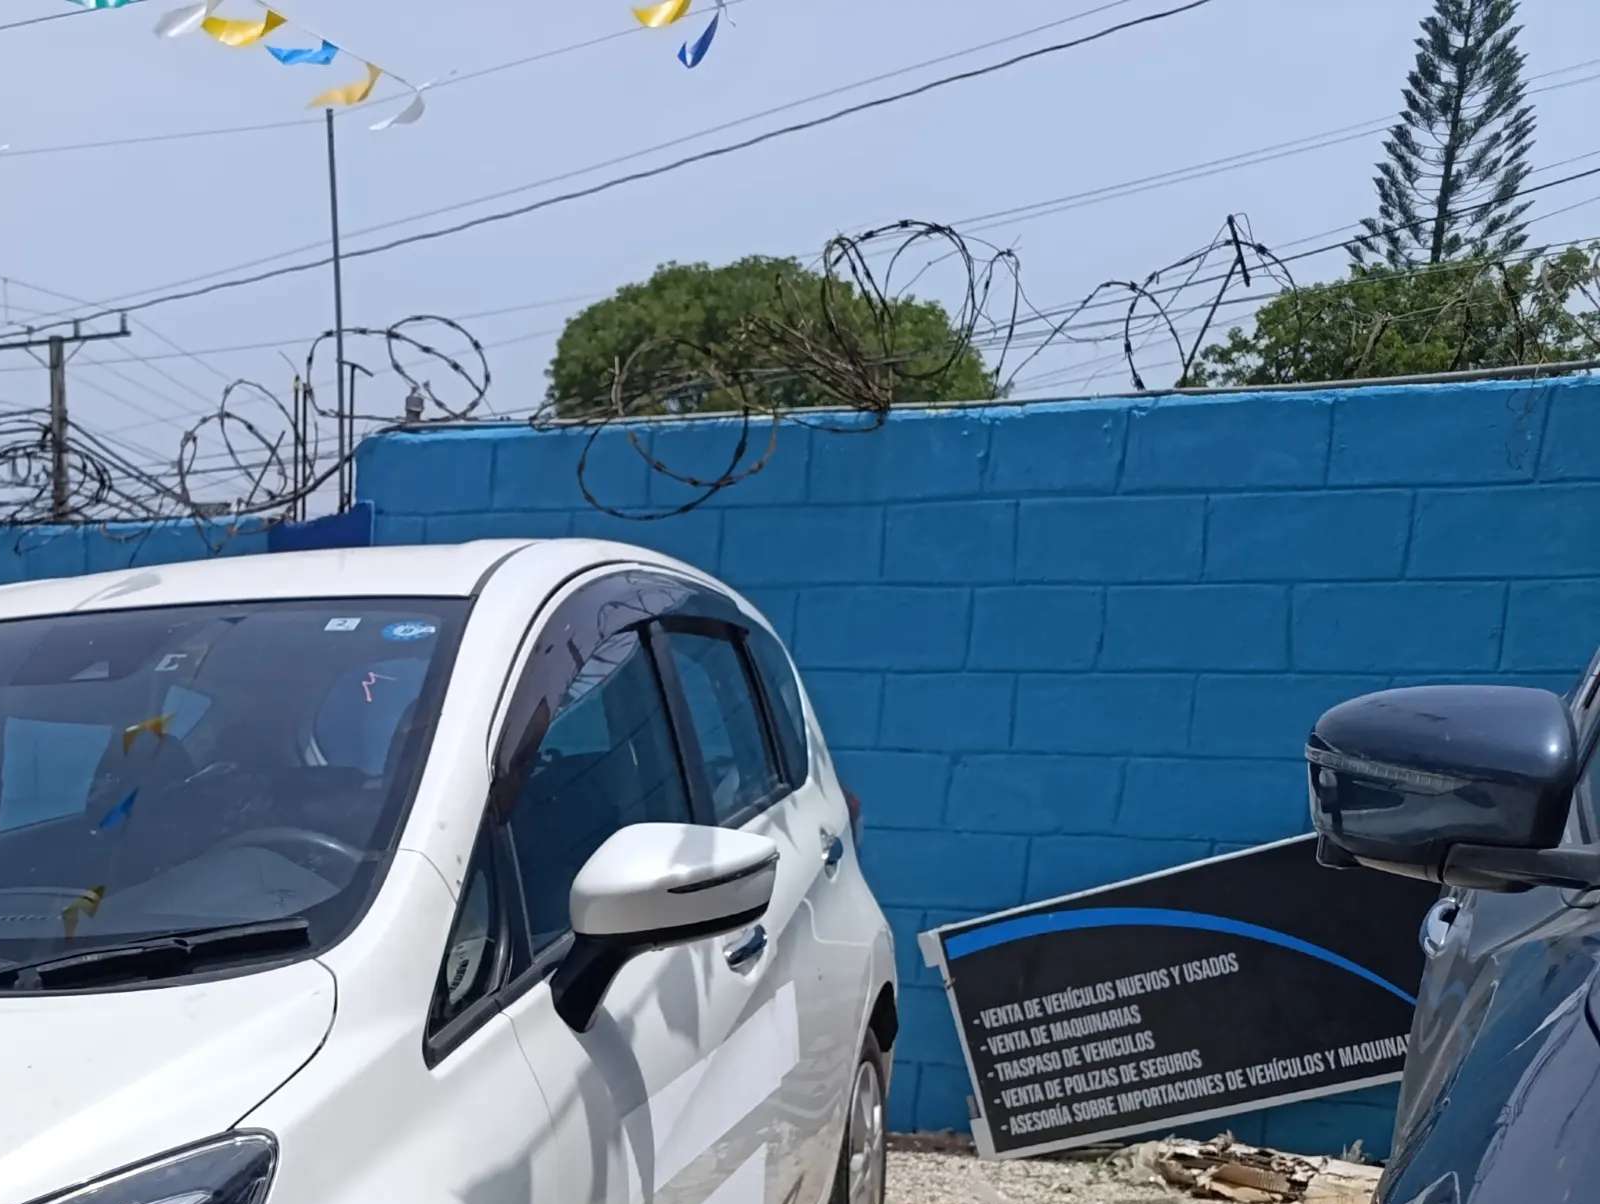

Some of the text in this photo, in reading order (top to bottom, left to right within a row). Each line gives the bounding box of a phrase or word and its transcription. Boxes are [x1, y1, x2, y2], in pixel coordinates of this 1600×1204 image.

[980, 1002, 1024, 1029] VENTA
[1023, 998, 1044, 1019] DE
[1041, 981, 1116, 1014] VEHÍCULOS
[1115, 968, 1170, 999] NUEVOS
[1170, 965, 1183, 985] Y
[1182, 952, 1239, 983] USADOS
[987, 1028, 1032, 1055] VENTA
[1030, 1024, 1050, 1045] DE
[1050, 1004, 1142, 1042] MAQUINARIAS
[994, 1051, 1063, 1082] TRASPASO
[1062, 1048, 1082, 1068] DE
[1081, 1030, 1156, 1063] VEHICULOS
[1001, 1081, 1045, 1109] VENTA
[1044, 1077, 1064, 1098] DE
[1064, 1061, 1120, 1096] POLIZAS
[1119, 1063, 1140, 1084] DE
[1139, 1048, 1203, 1079] SEGUROS
[1009, 1102, 1073, 1135] ASESORÍA
[1072, 1095, 1117, 1122] SOBRE
[1117, 1074, 1225, 1108] IMPORTACIONES
[1225, 1067, 1247, 1091] DE
[1246, 1055, 1326, 1087] VEHÍCULOS
[1324, 1049, 1338, 1069] Y
